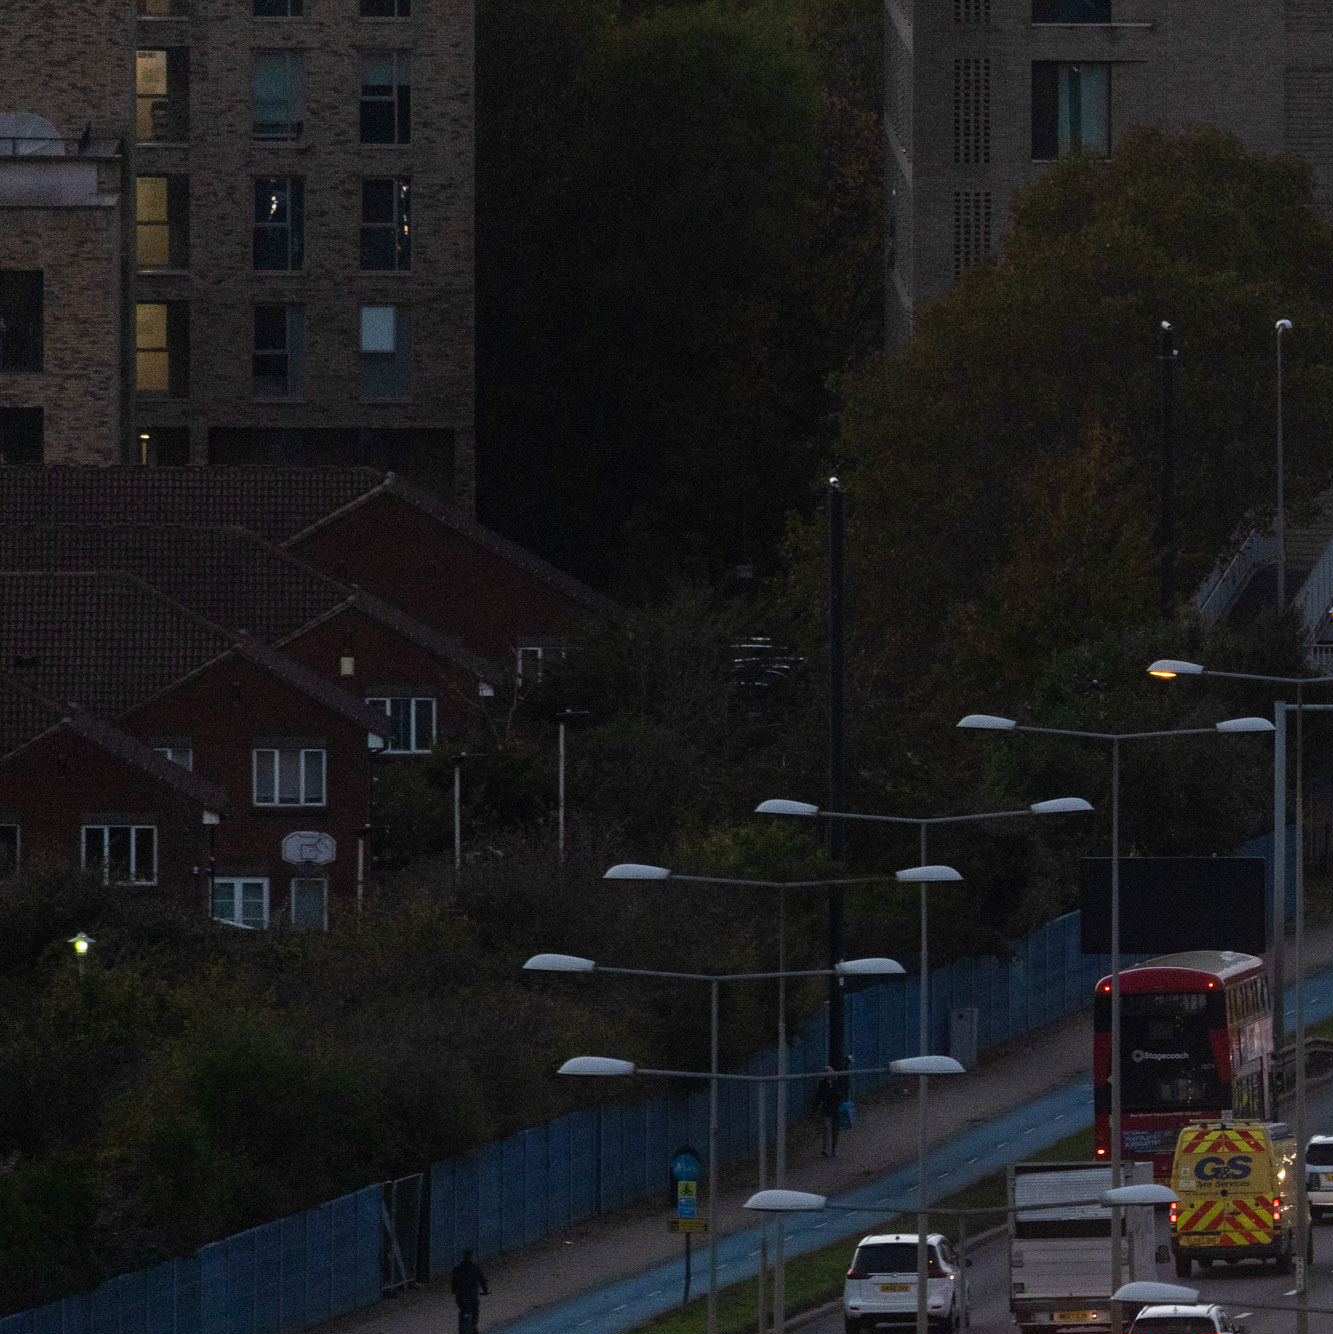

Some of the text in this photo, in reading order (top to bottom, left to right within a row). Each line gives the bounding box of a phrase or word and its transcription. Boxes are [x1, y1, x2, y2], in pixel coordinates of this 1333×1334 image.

[1144, 1051, 1190, 1061] Stagecoach
[1194, 1155, 1253, 1181] G&S
[1196, 1180, 1250, 1190] Tyre Services
